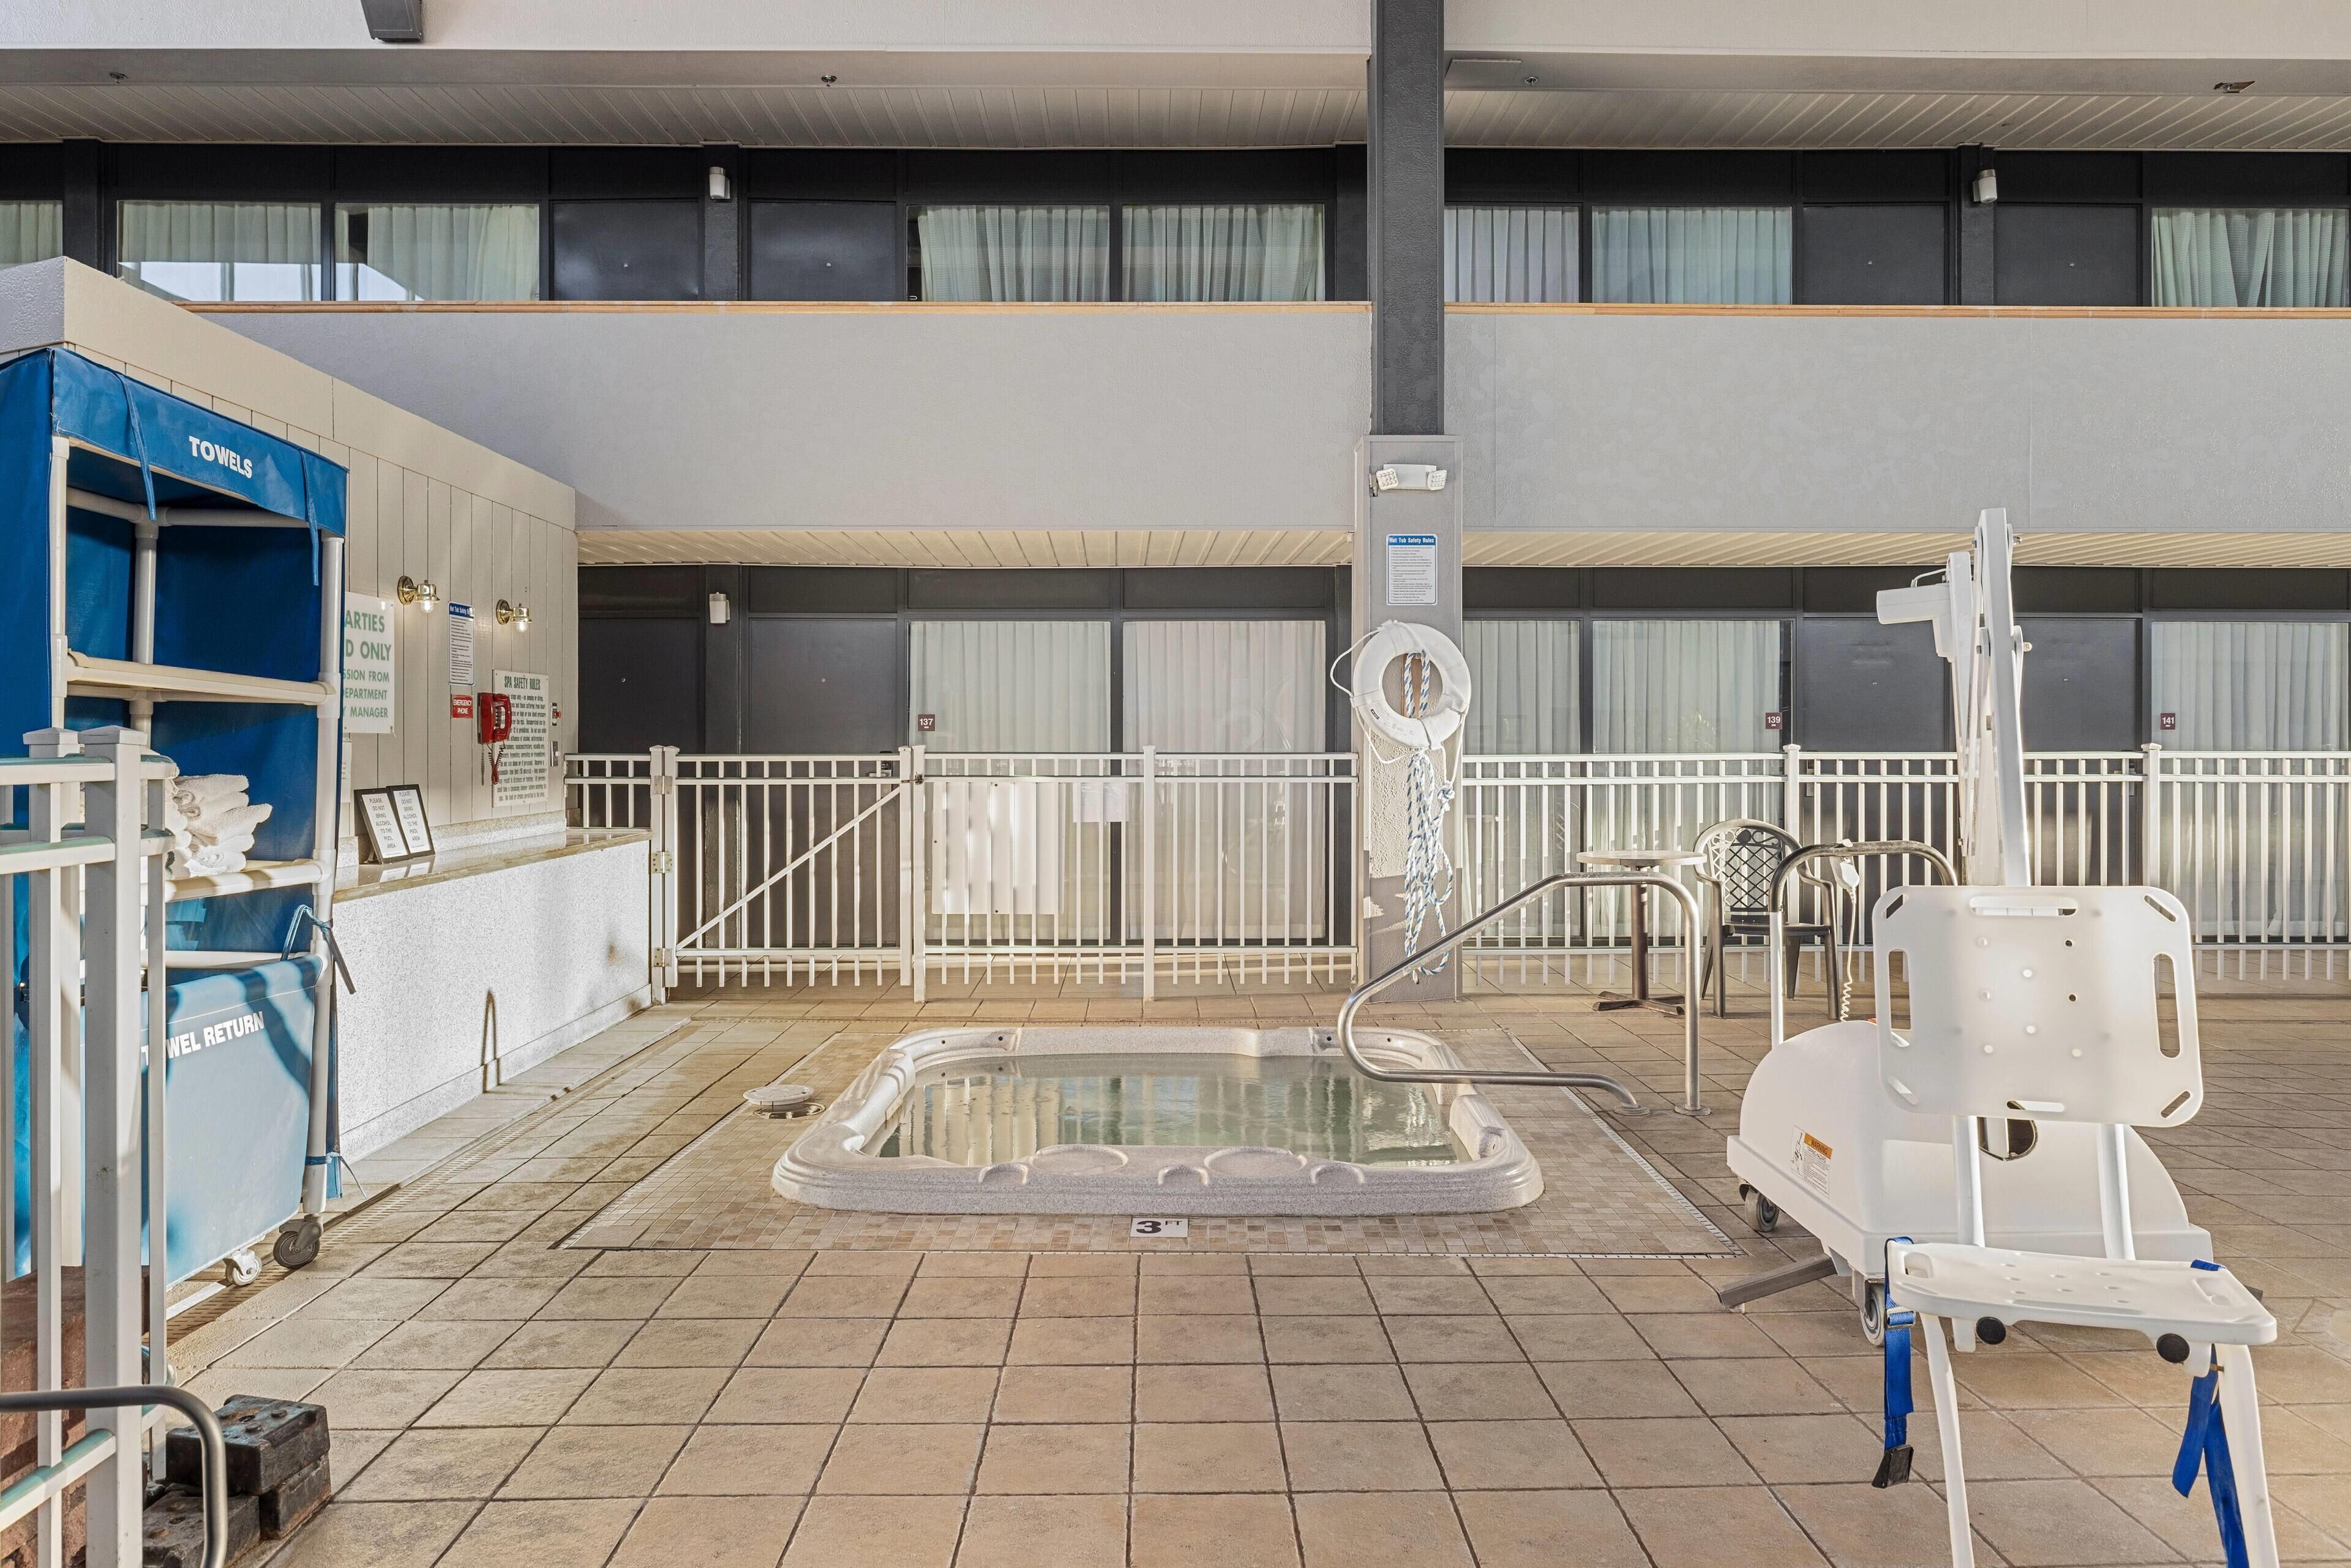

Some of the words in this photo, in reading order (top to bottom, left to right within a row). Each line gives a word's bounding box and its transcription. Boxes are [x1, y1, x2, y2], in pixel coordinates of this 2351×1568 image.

[189, 435, 252, 479] TOWELS
[344, 610, 385, 633] ARTIES
[360, 641, 392, 661] ONLY
[342, 669, 366, 681] SSION
[369, 670, 389, 682] FROM
[514, 677, 528, 689] SAFETY
[530, 678, 541, 690] RULES
[342, 688, 387, 700] EPARTMENT
[350, 707, 388, 718] MANAGER
[141, 1031, 201, 1066] TWEL
[203, 1011, 264, 1047] RETURN
[1811, 1139, 1828, 1155] WARNING
[1136, 1220, 1161, 1234] 3
